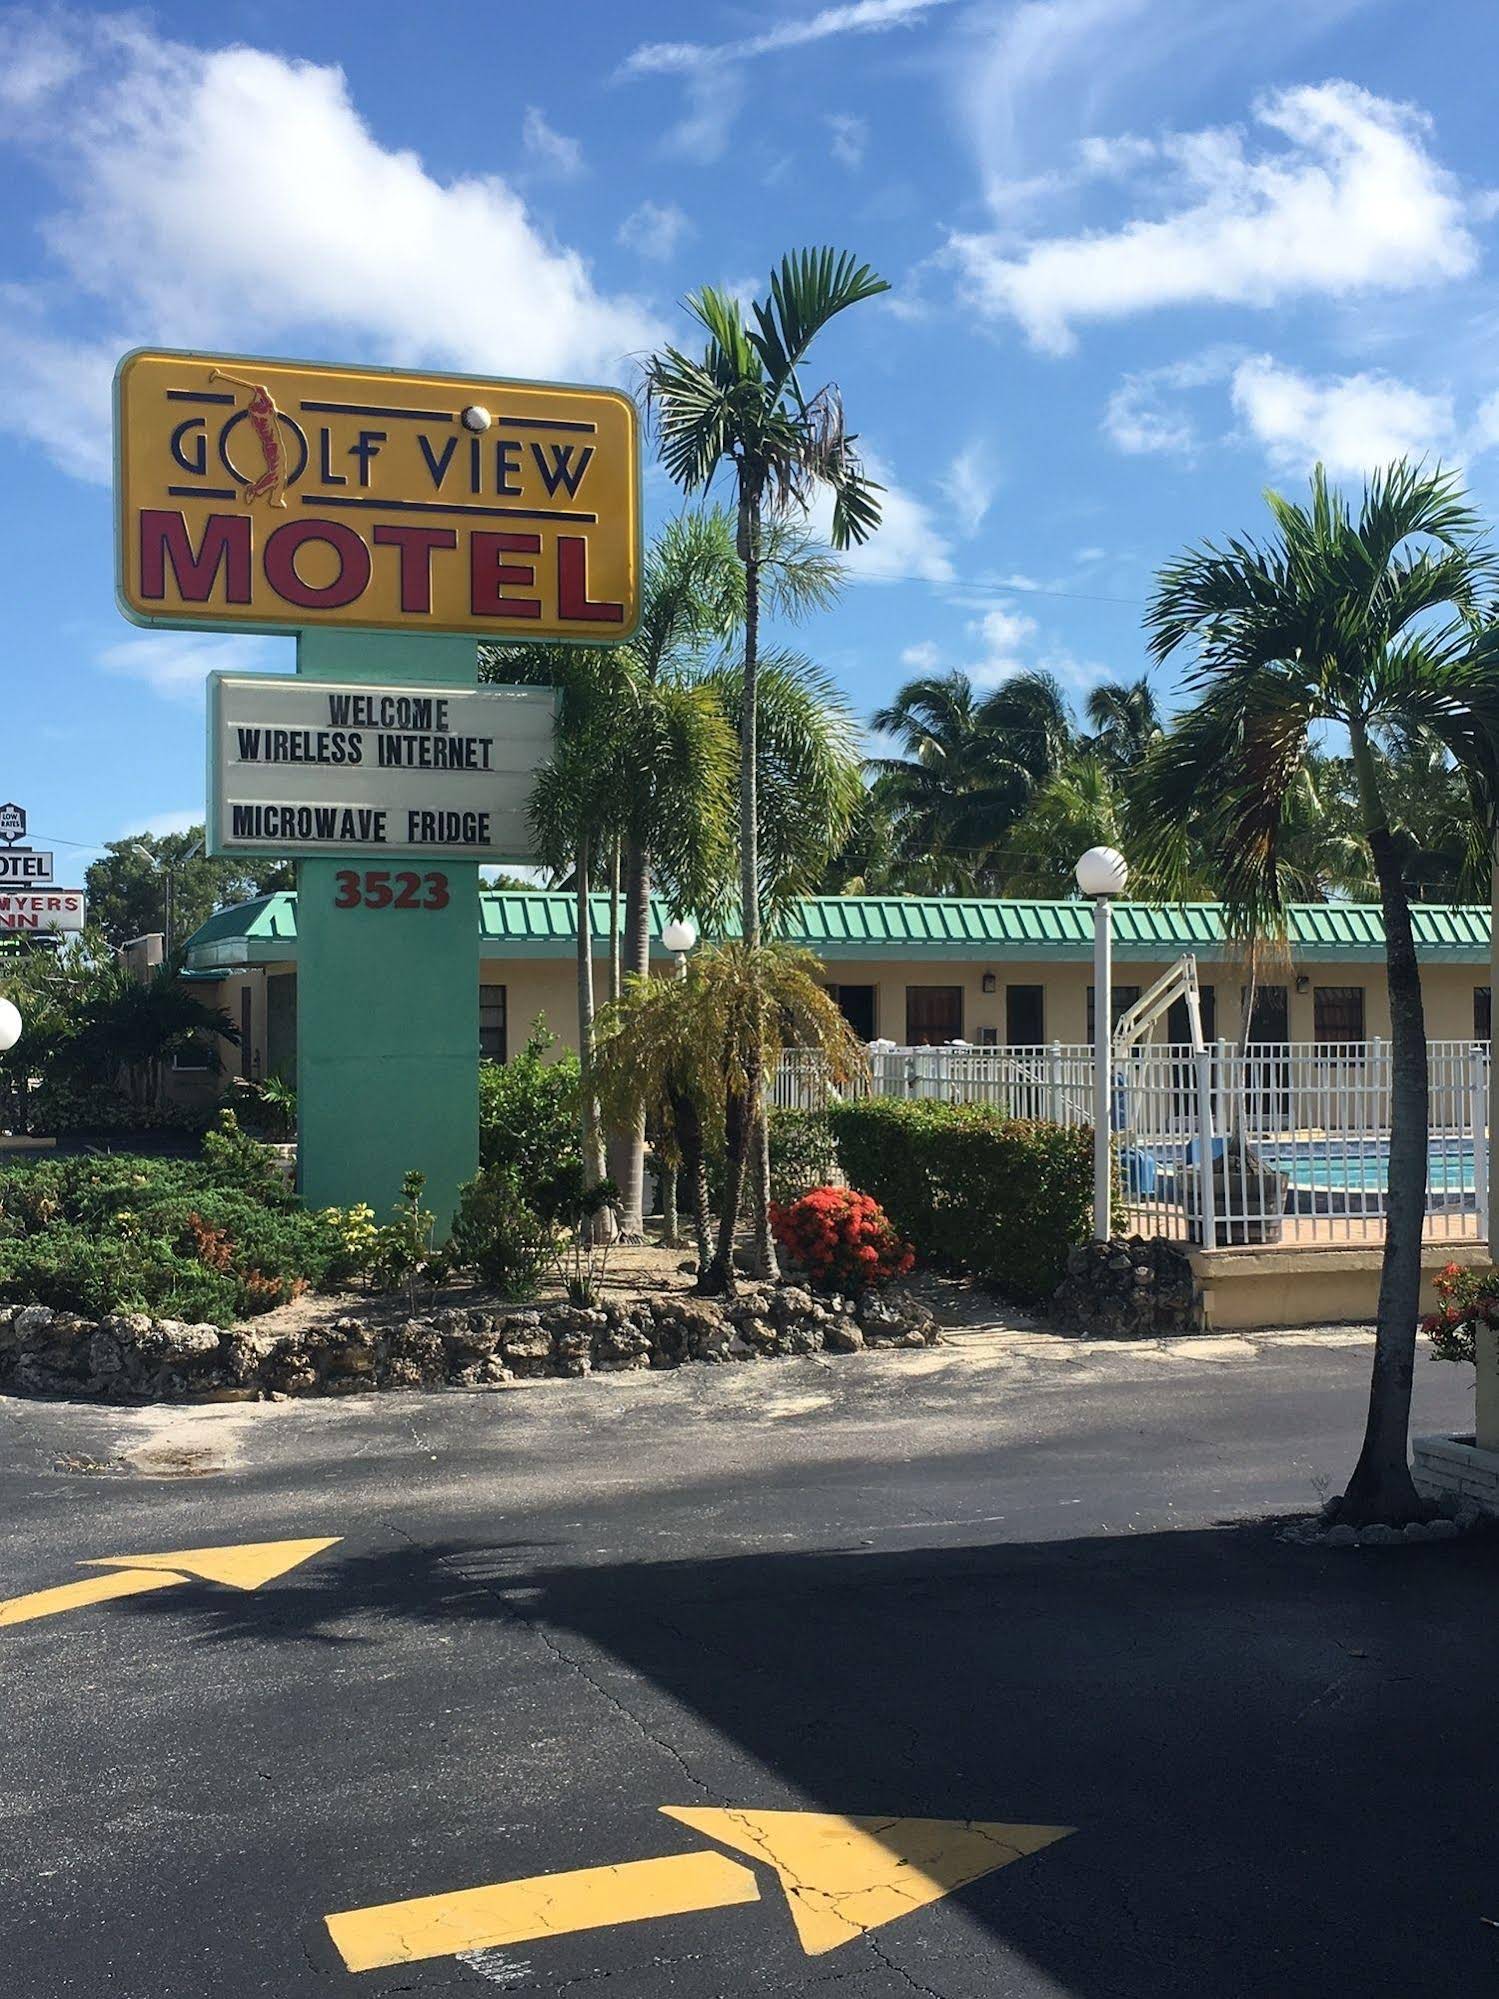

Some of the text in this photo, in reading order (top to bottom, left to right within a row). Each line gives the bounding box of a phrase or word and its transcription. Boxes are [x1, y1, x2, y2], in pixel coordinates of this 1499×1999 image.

[171, 409, 596, 500] GOLF VIEW
[139, 508, 624, 622] MOTEL
[329, 694, 449, 731] WELCOME
[237, 728, 494, 770] WIRELESS INTERNET
[1, 820, 20, 828] RATES
[232, 805, 491, 845] MICROWAVE FRIDGE
[0, 897, 78, 911] MYERS
[334, 869, 451, 910] 3523
